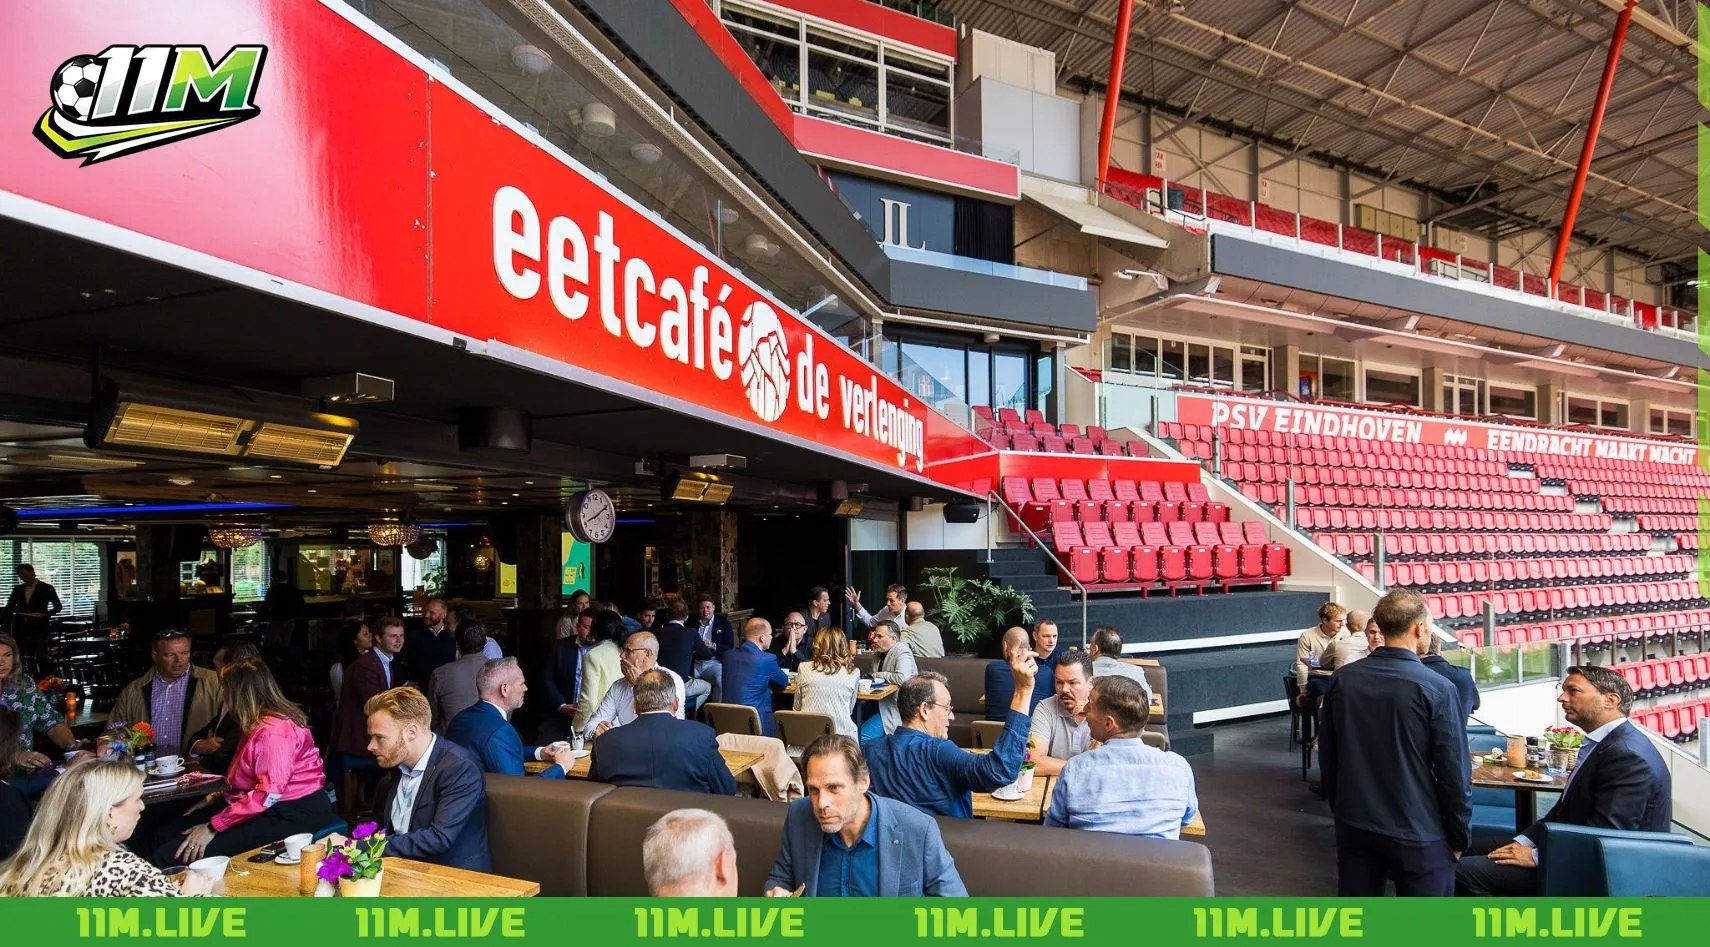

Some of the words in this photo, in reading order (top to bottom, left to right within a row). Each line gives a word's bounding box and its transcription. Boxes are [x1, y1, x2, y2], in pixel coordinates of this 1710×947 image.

[493, 185, 733, 380] eetcafé
[797, 332, 830, 420] de
[840, 374, 924, 473] verlenging
[1211, 401, 1268, 431] PSV
[1274, 408, 1423, 444] EINDHOVEN
[1487, 429, 1593, 458] EENDRACHT
[1594, 439, 1647, 462] MAAKT
[1649, 444, 1696, 466] MACHT
